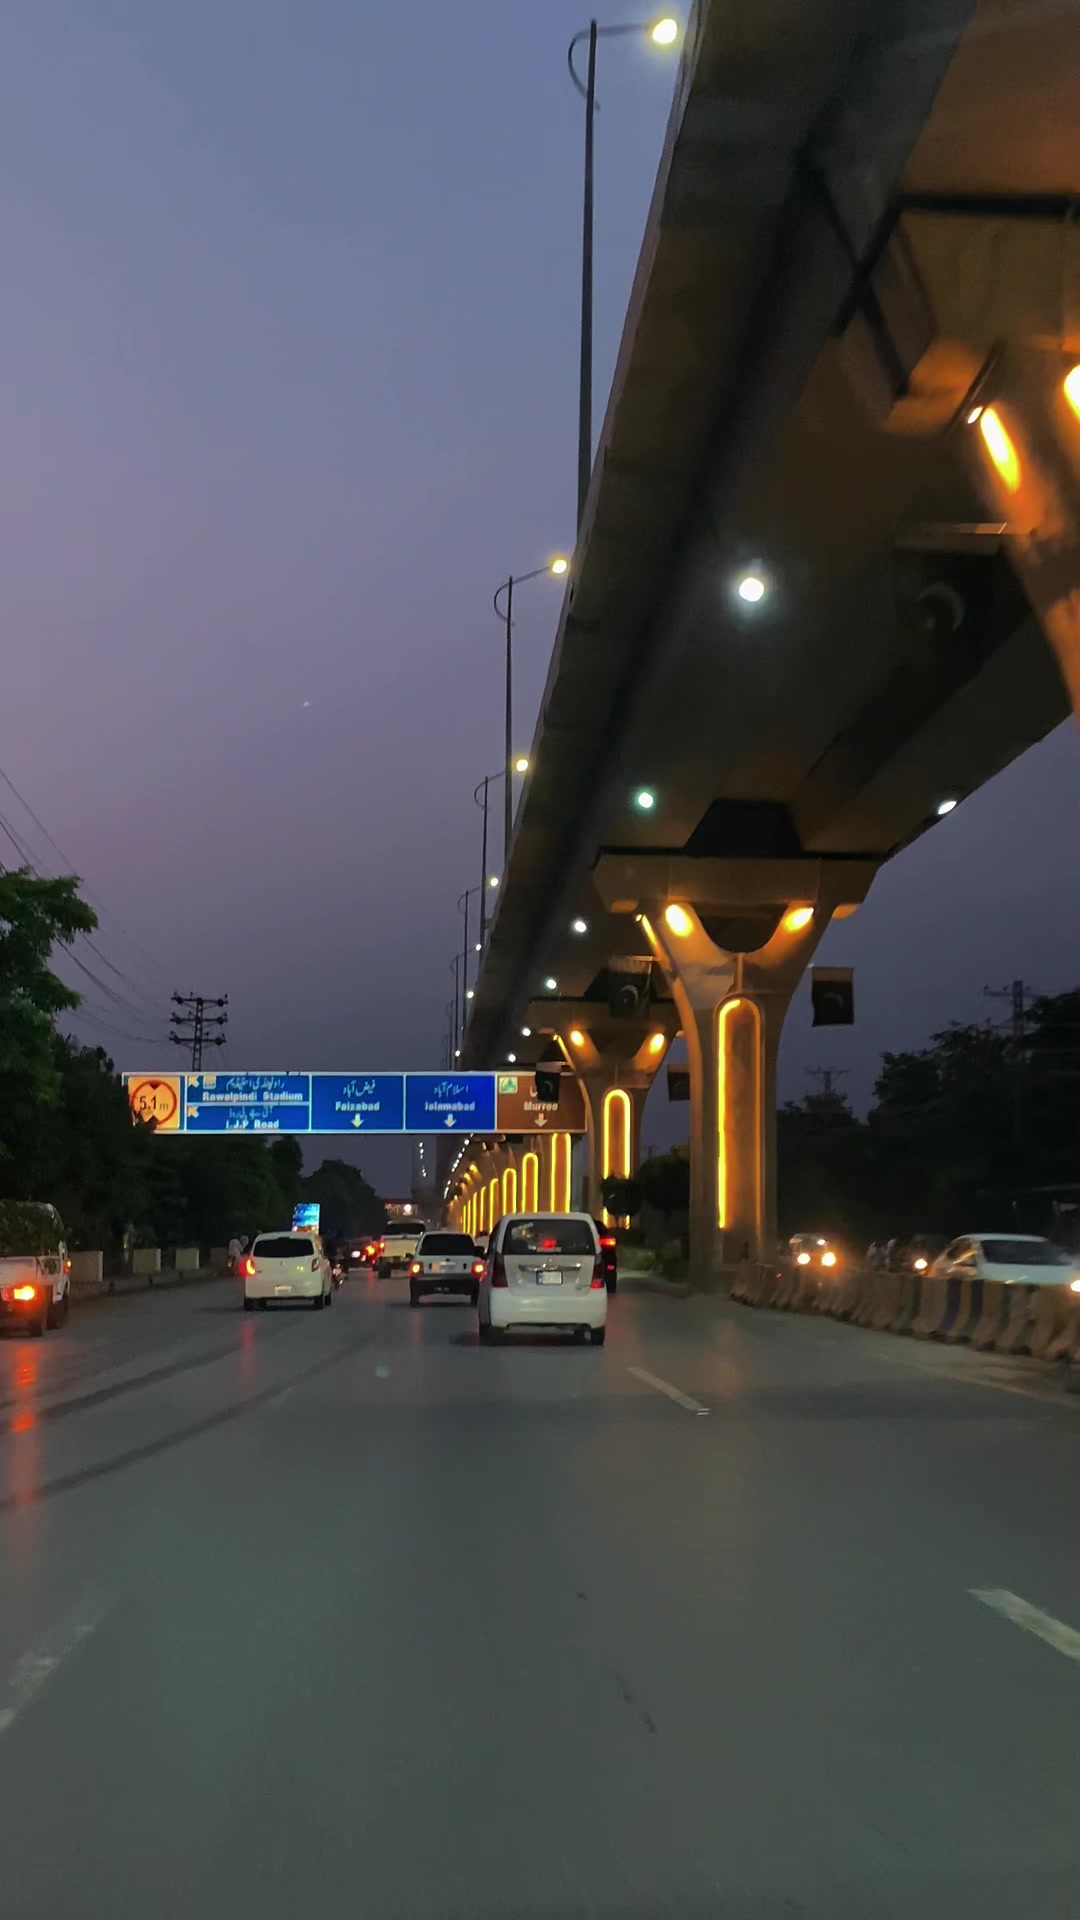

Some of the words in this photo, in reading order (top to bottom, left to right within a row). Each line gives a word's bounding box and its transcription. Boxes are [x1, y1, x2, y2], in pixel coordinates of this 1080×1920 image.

[202, 1091, 257, 1102] Rawalpindi
[263, 1091, 303, 1102] Stadium
[139, 1095, 157, 1110] 5.1
[335, 1101, 380, 1111] Faizabad
[424, 1101, 476, 1111] Islamabad
[523, 1101, 559, 1111] Murree
[254, 1119, 280, 1129] Road
